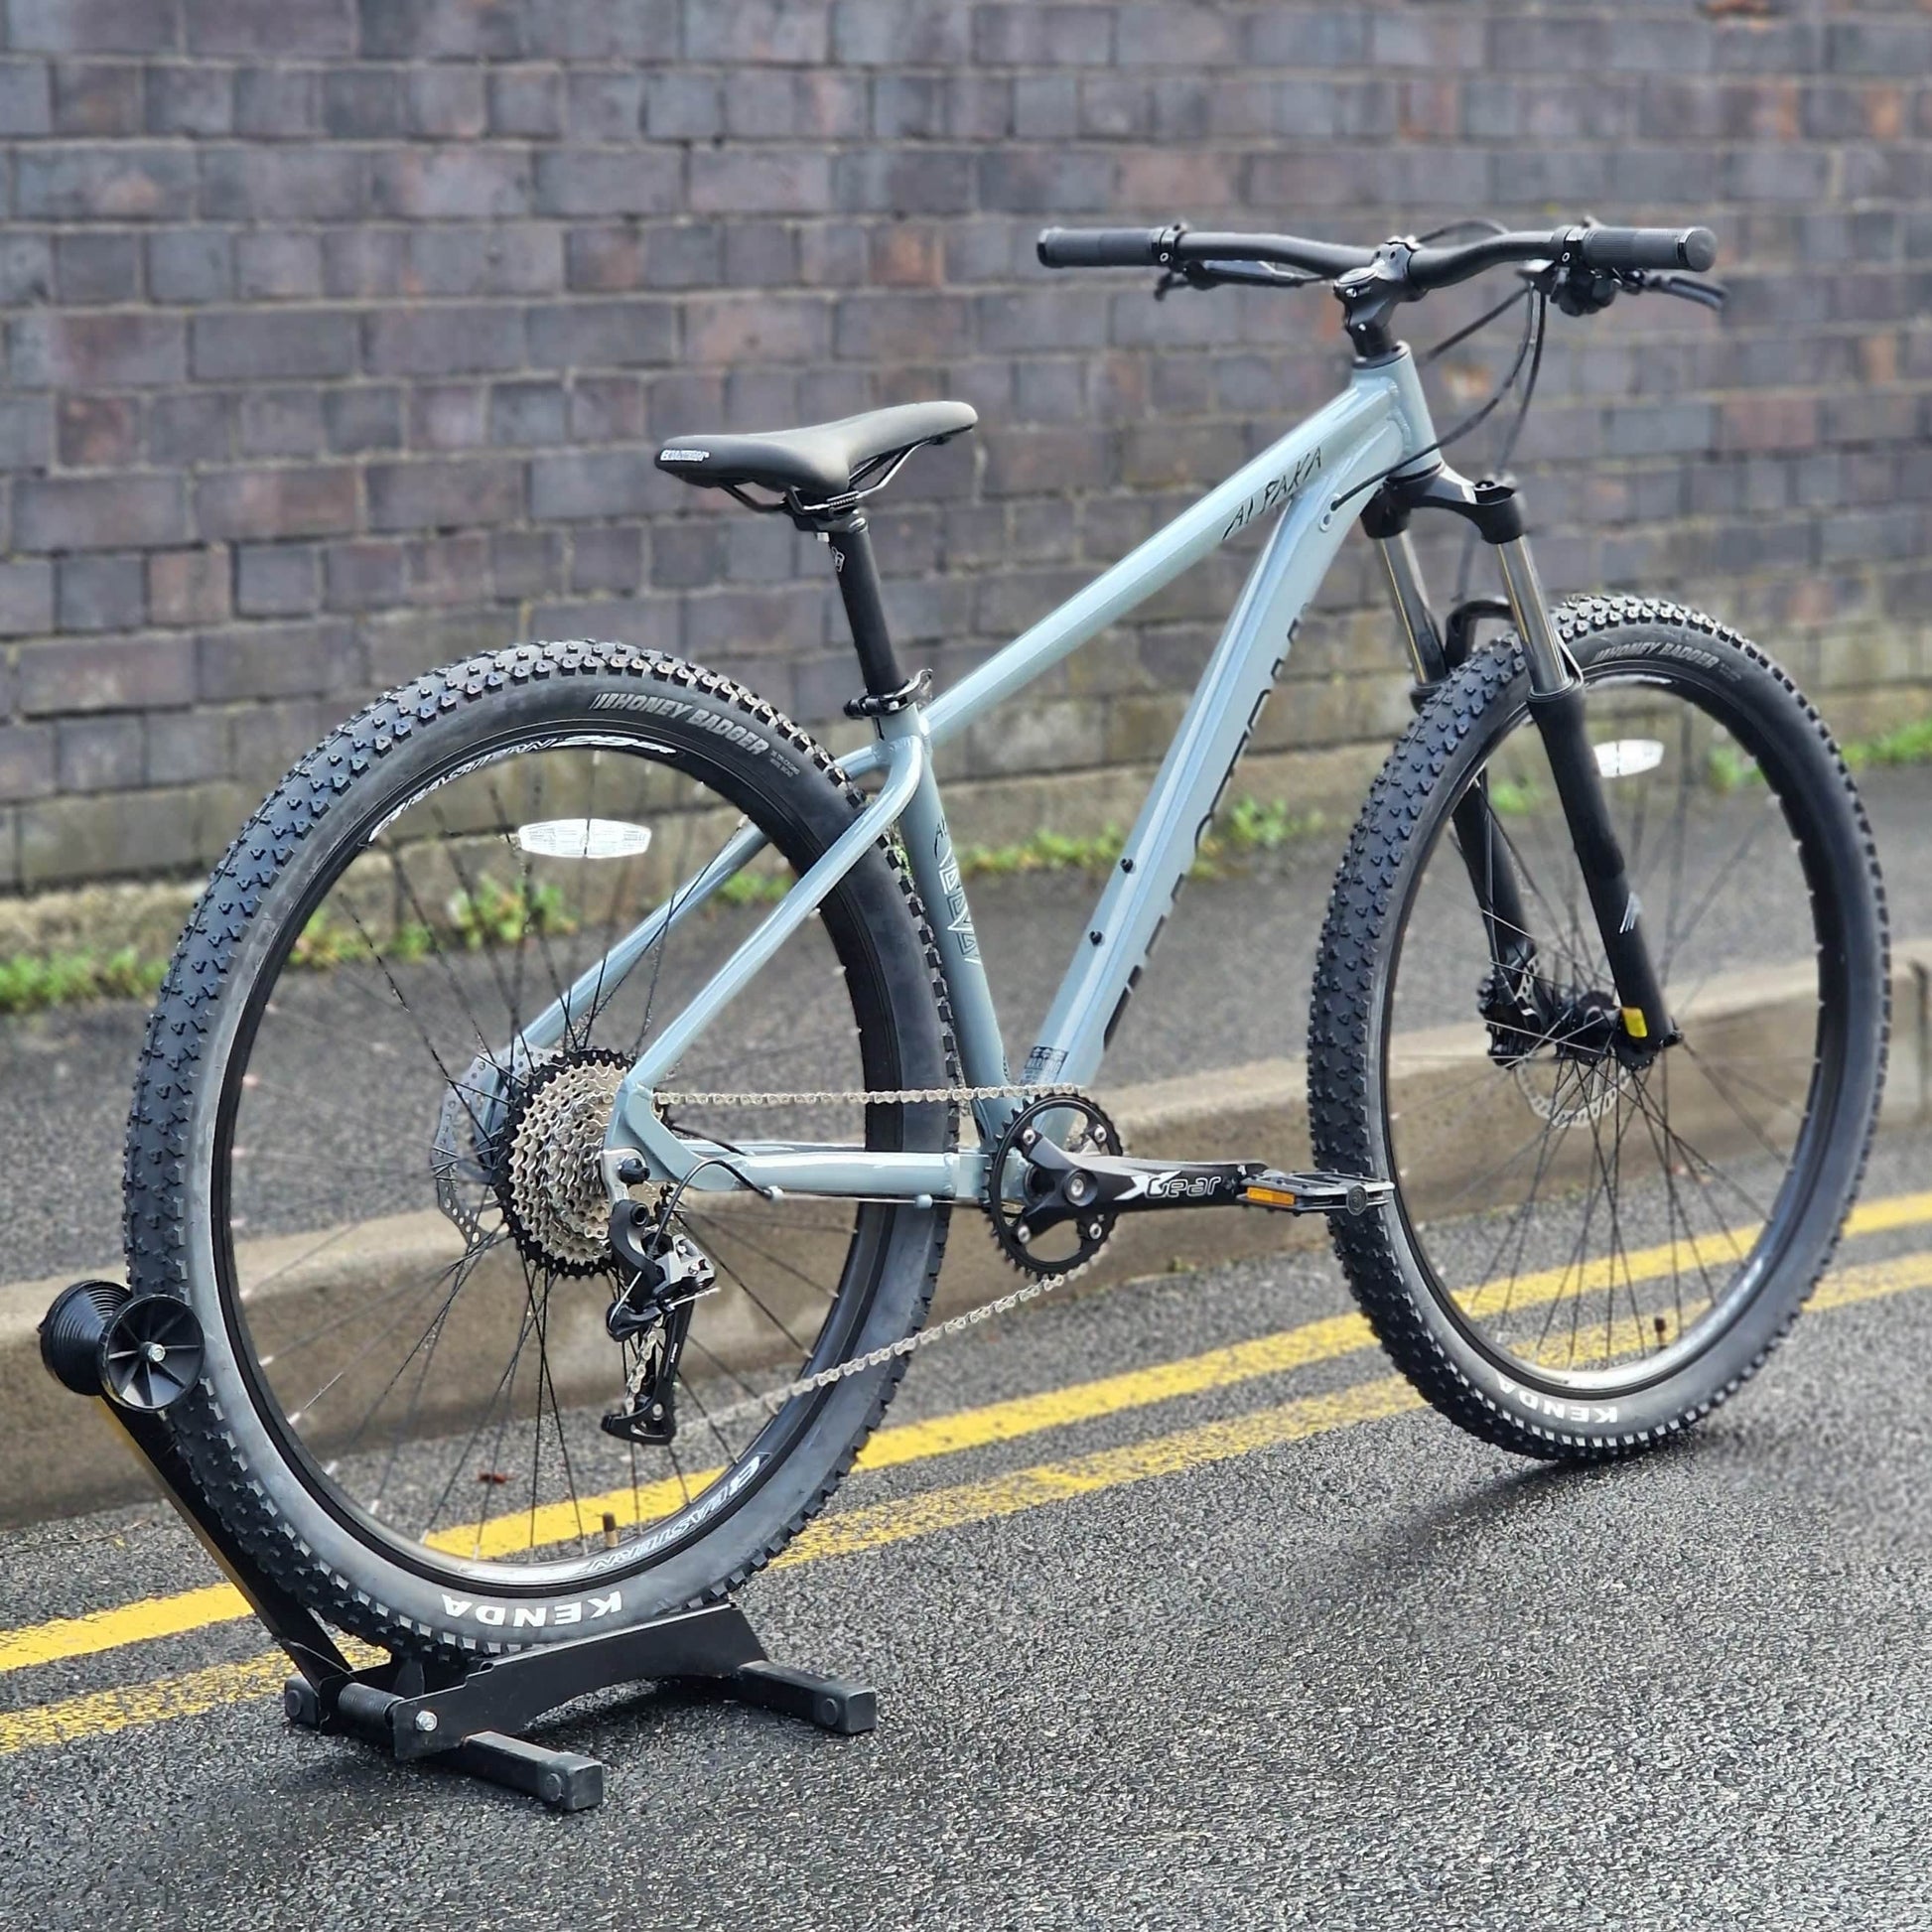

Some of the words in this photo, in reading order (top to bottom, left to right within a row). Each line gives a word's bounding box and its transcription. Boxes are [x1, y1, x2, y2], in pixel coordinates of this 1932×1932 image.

[1606, 642, 1662, 658] HONEY
[1658, 642, 1720, 668] BADGER
[612, 693, 693, 719] HONEY
[686, 709, 770, 756] BADGER
[1496, 1370, 1619, 1424] KENDA
[442, 1590, 622, 1628] KENDA
